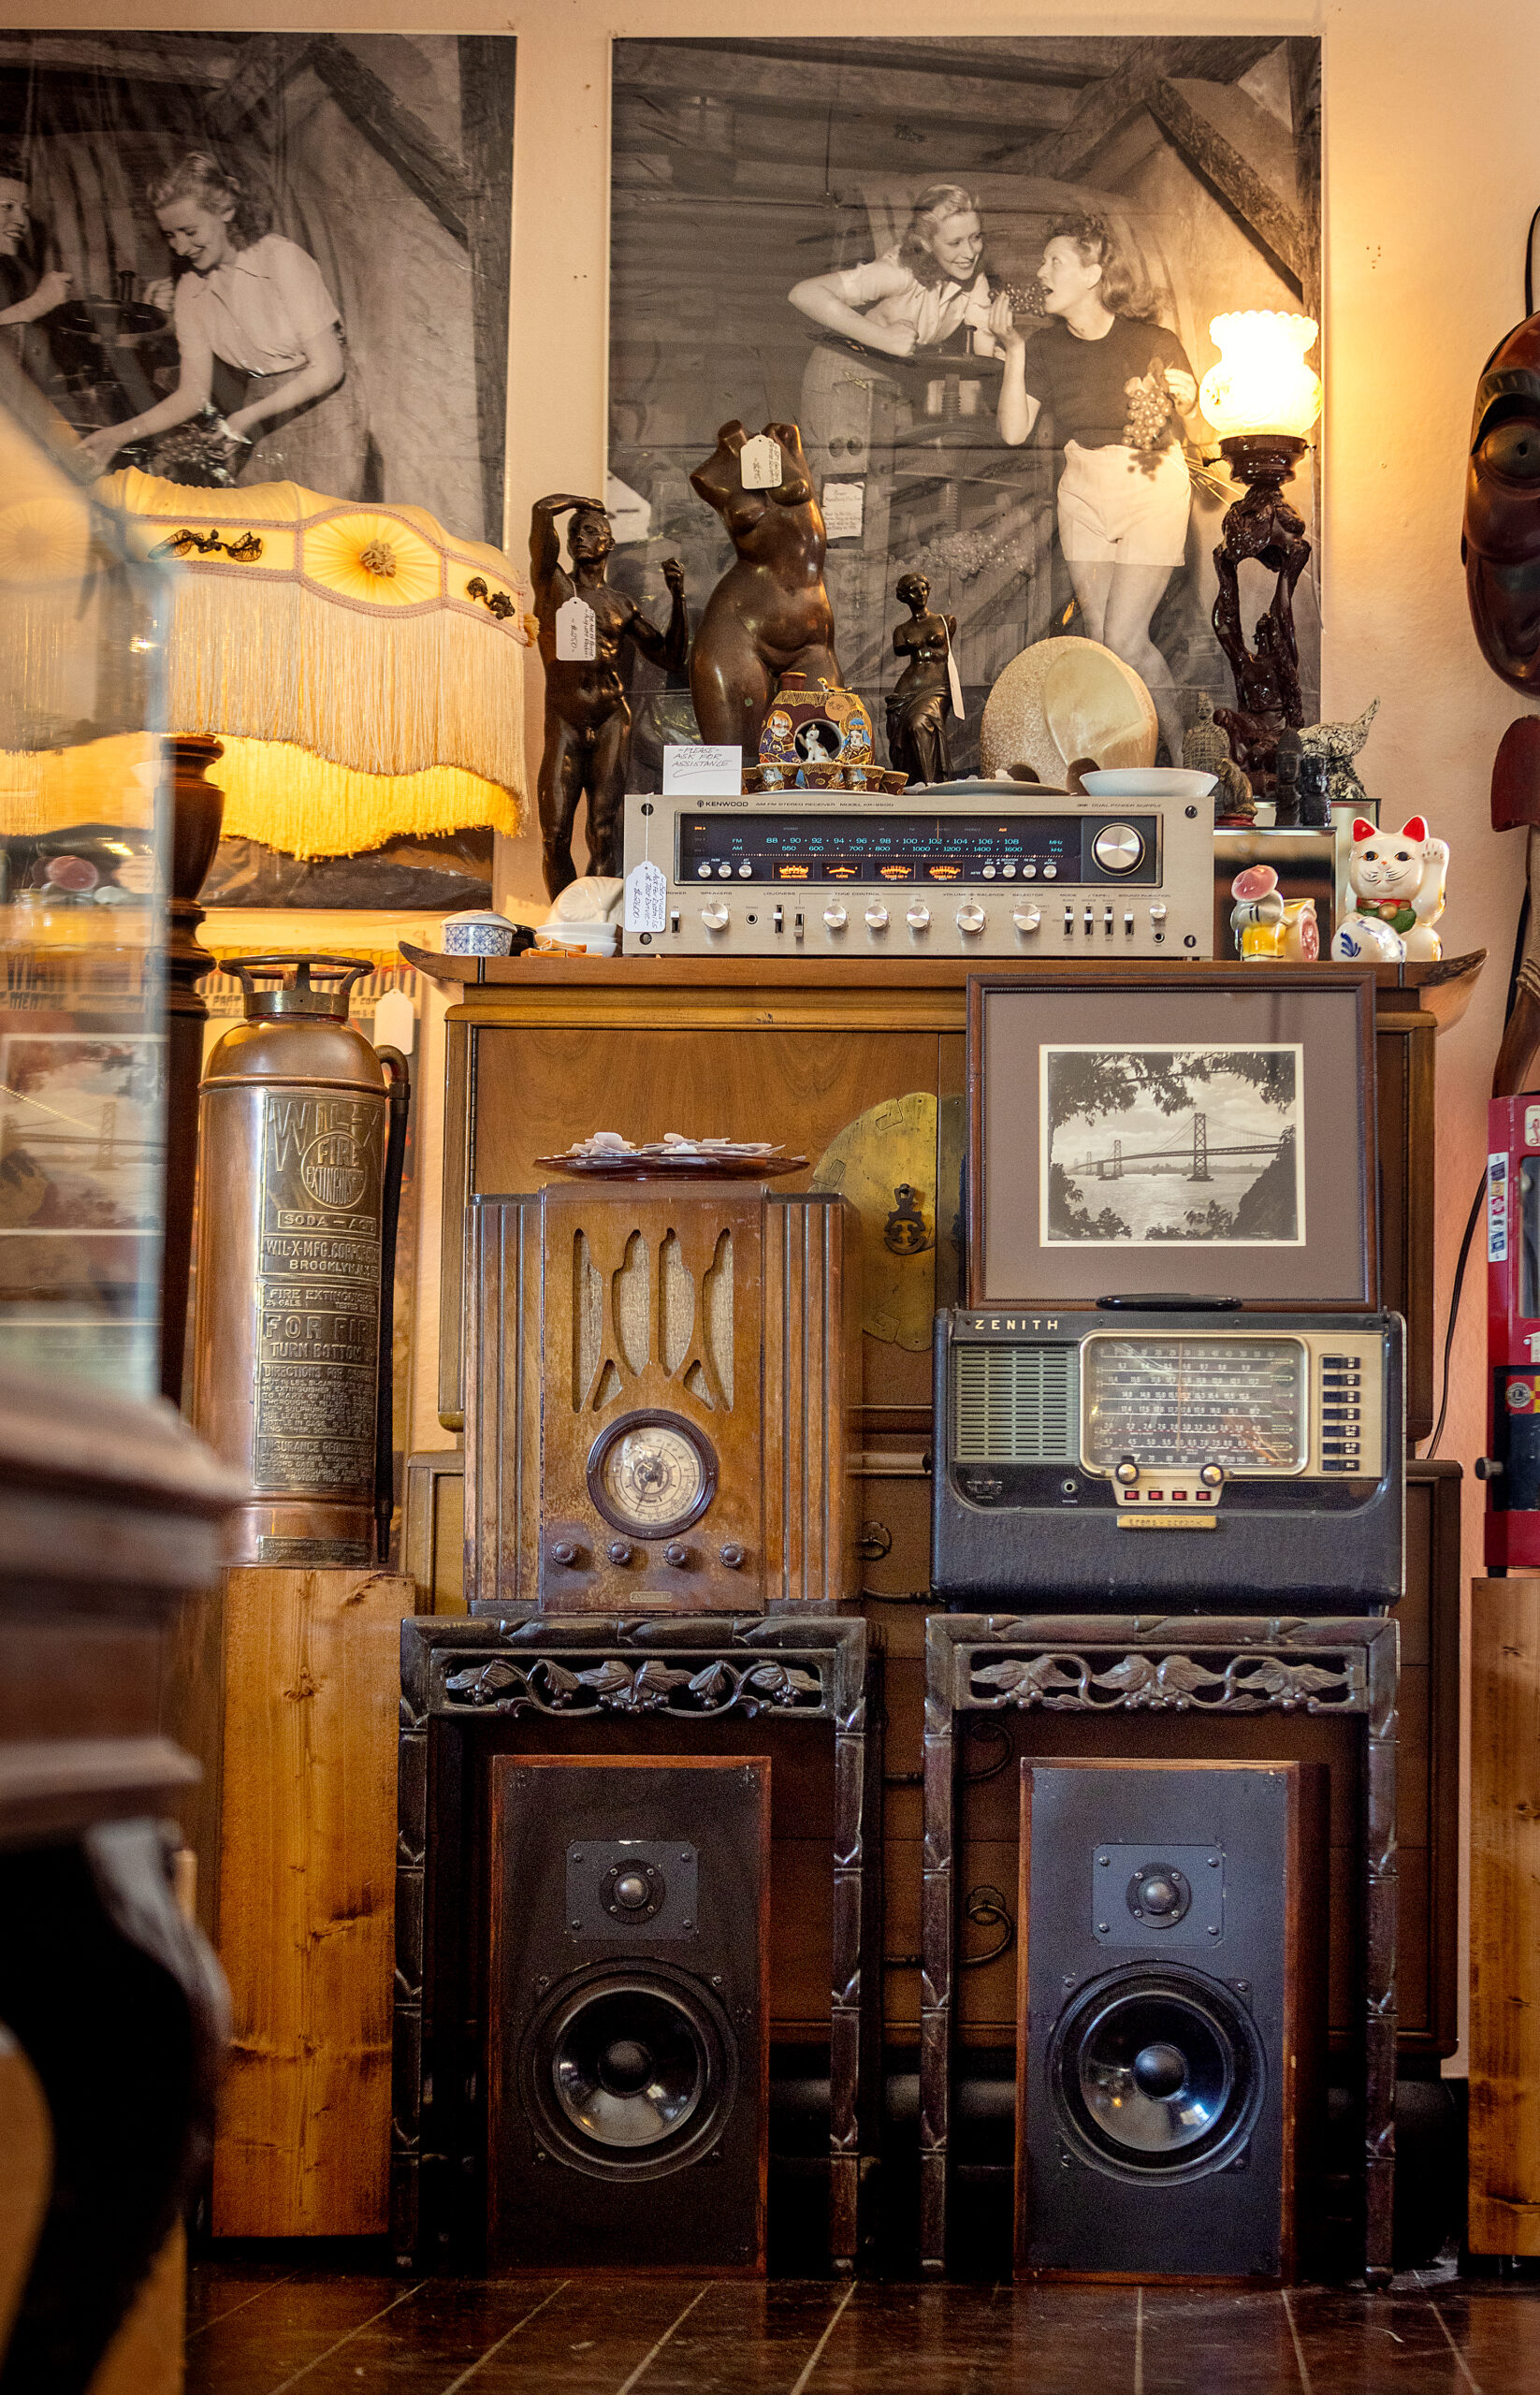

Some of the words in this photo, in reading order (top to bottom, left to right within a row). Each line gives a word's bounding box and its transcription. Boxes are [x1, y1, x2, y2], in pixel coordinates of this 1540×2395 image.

[317, 1136, 359, 1168] FIRE
[283, 1213, 328, 1227] SODA
[270, 1288, 301, 1299] FIRE
[266, 1314, 322, 1340] FOR
[975, 1320, 1059, 1330] ZENITH
[269, 1342, 310, 1358] TURN
[313, 1343, 361, 1360] BOTTOM
[264, 1366, 321, 1378] DIRECTIONS
